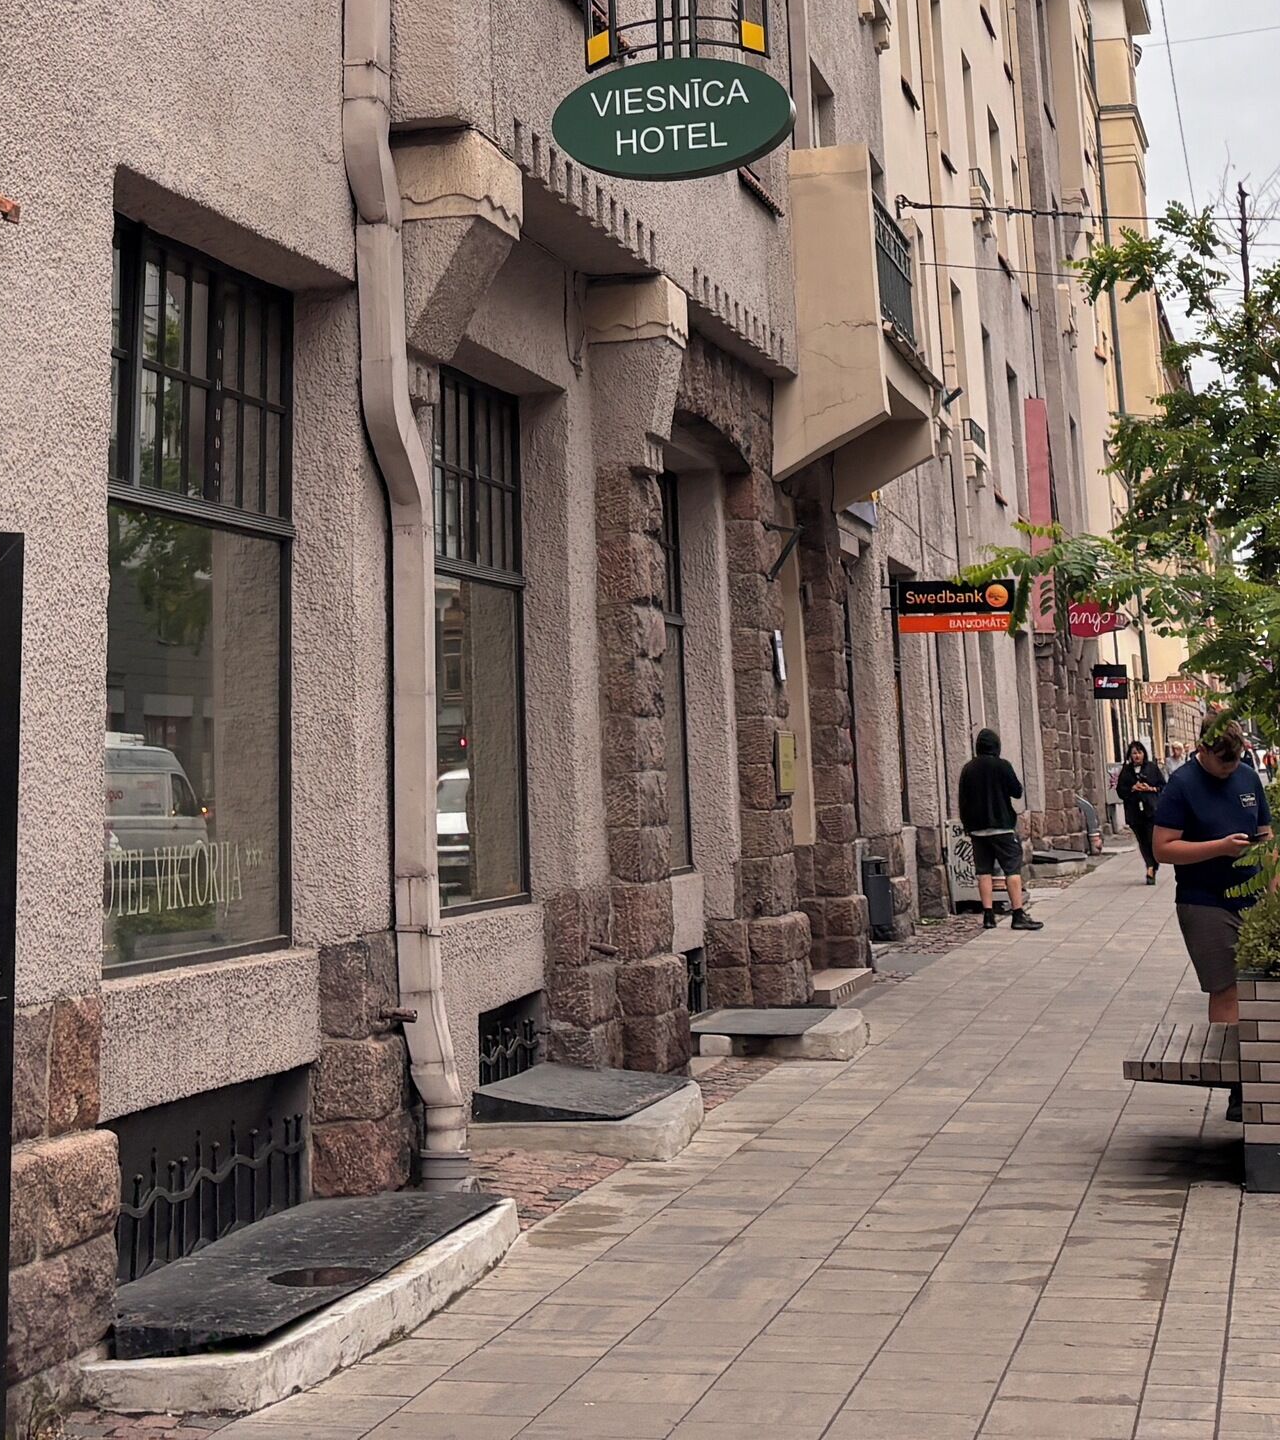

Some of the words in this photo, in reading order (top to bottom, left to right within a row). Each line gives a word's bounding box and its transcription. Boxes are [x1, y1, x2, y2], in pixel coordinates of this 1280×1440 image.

[590, 78, 750, 117] VIESNĪCA
[616, 121, 728, 156] HOTEL
[906, 589, 983, 605] Swedbank
[949, 618, 1008, 629] BANKOMĀTS
[104, 848, 150, 919] OTEL
[154, 841, 243, 918] VIKTORIJA
